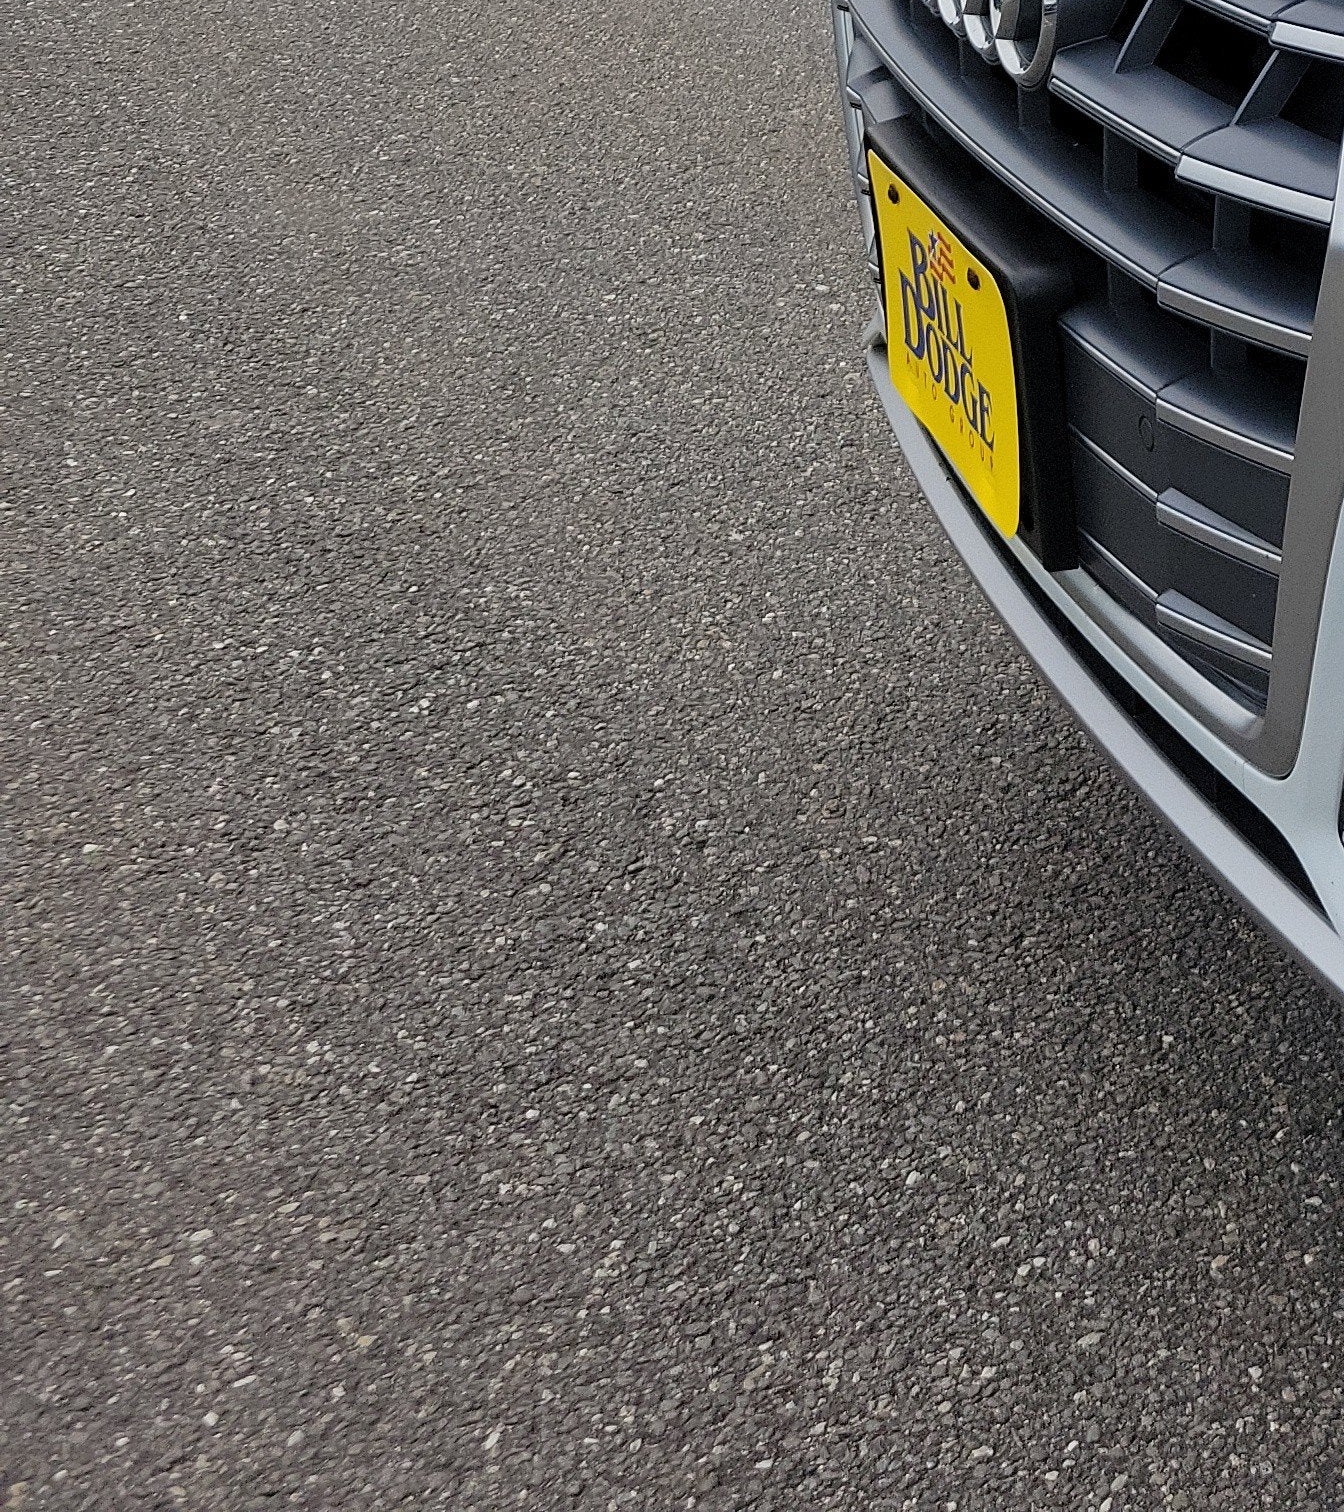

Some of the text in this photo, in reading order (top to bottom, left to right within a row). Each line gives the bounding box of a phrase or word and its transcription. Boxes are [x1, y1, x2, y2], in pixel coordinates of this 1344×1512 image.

[898, 266, 996, 453] DODGE
[907, 227, 973, 368] BILL
[906, 351, 938, 401] AUTO
